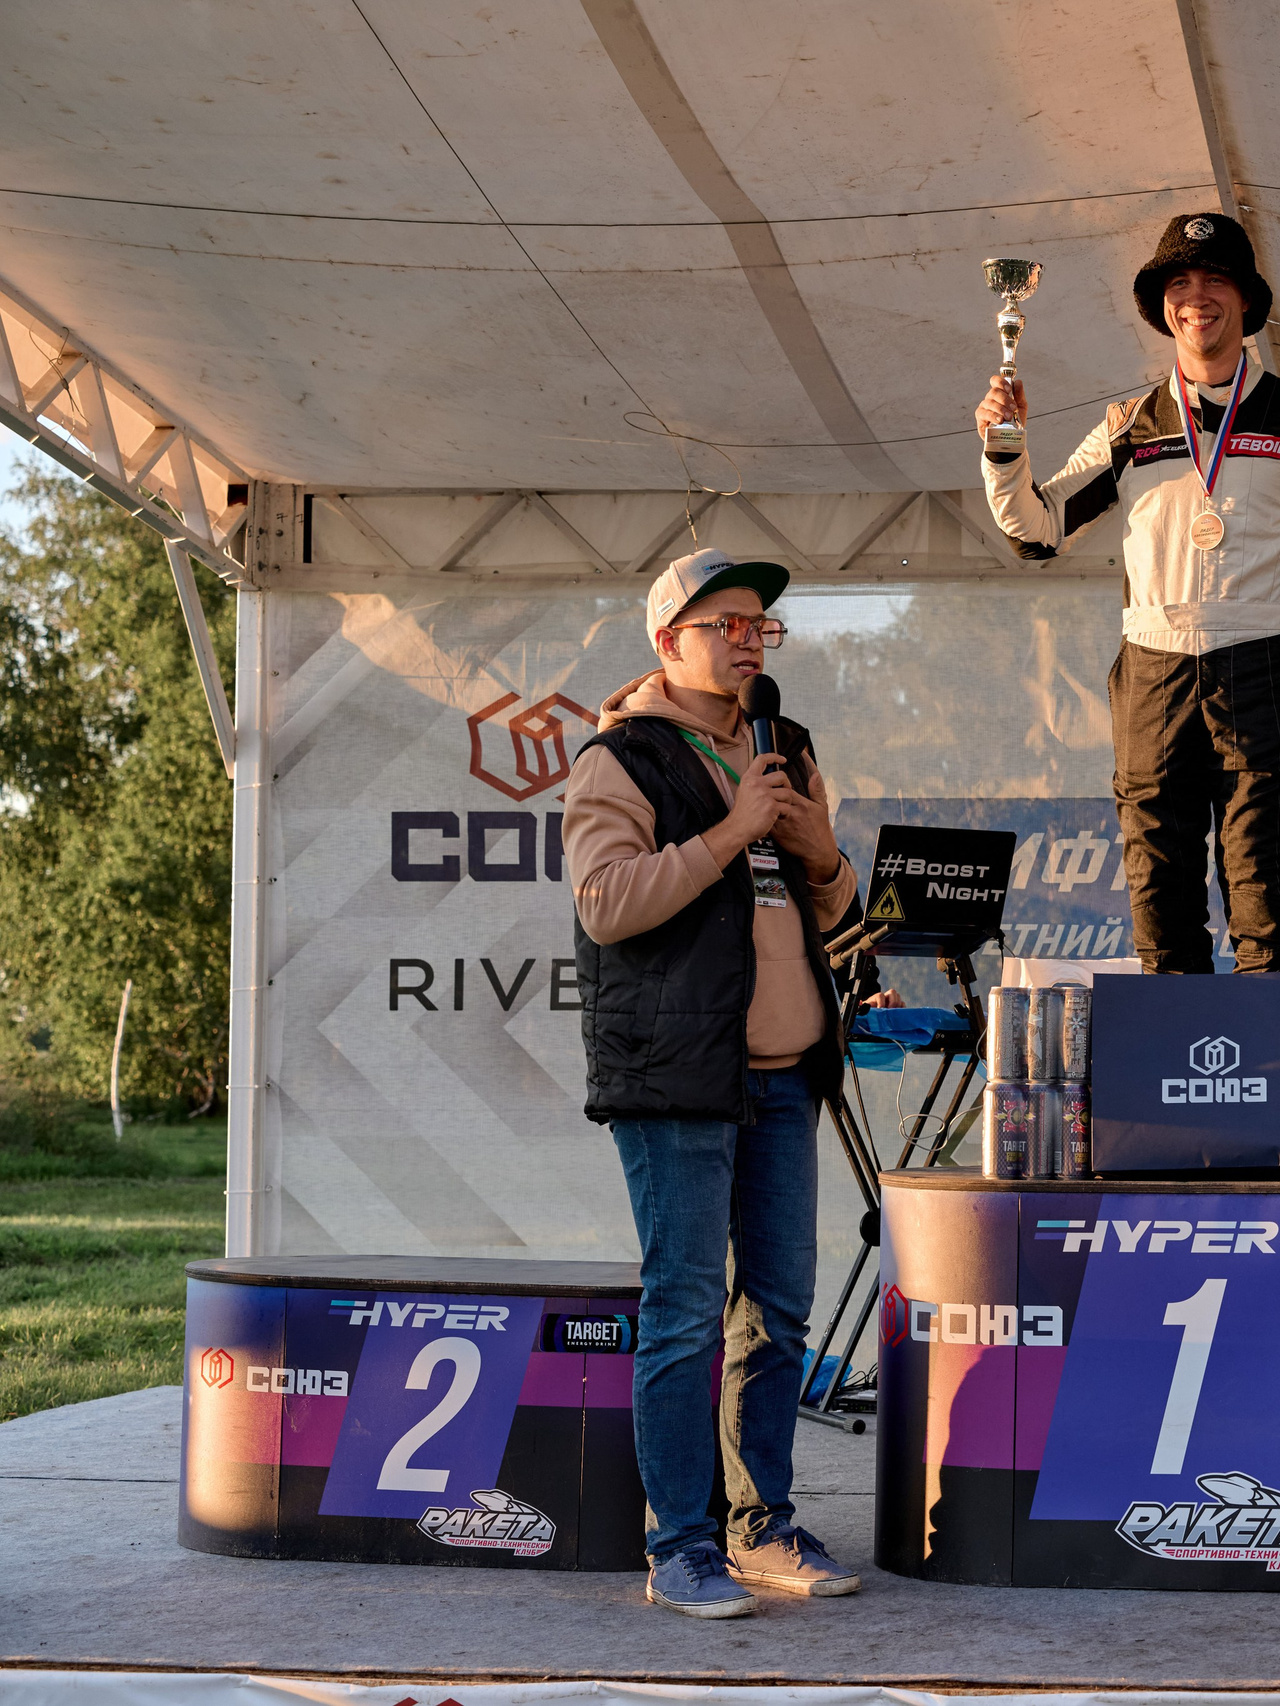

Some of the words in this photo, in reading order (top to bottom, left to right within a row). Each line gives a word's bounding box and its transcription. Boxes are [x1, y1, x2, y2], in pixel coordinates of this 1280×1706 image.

[1134, 443, 1162, 460] RDS
[389, 958, 584, 1011] RIVE
[1162, 1077, 1268, 1104] СОЮЗ
[1003, 1140, 1027, 1152] TARET
[1062, 1220, 1280, 1254] HYPER
[349, 1300, 510, 1331] HYPER
[565, 1320, 620, 1341] TARGET
[910, 1300, 1064, 1347] СОЮЗ
[246, 1366, 349, 1397] СОЮЗ
[1150, 1278, 1228, 1475] 1
[376, 1336, 482, 1493] 2
[419, 1508, 553, 1540] РАКЕТА
[454, 1538, 551, 1549] СПОРТИВНО-ТЕХНИЧЕСКИЙ
[515, 1548, 536, 1556] КЛУБ
